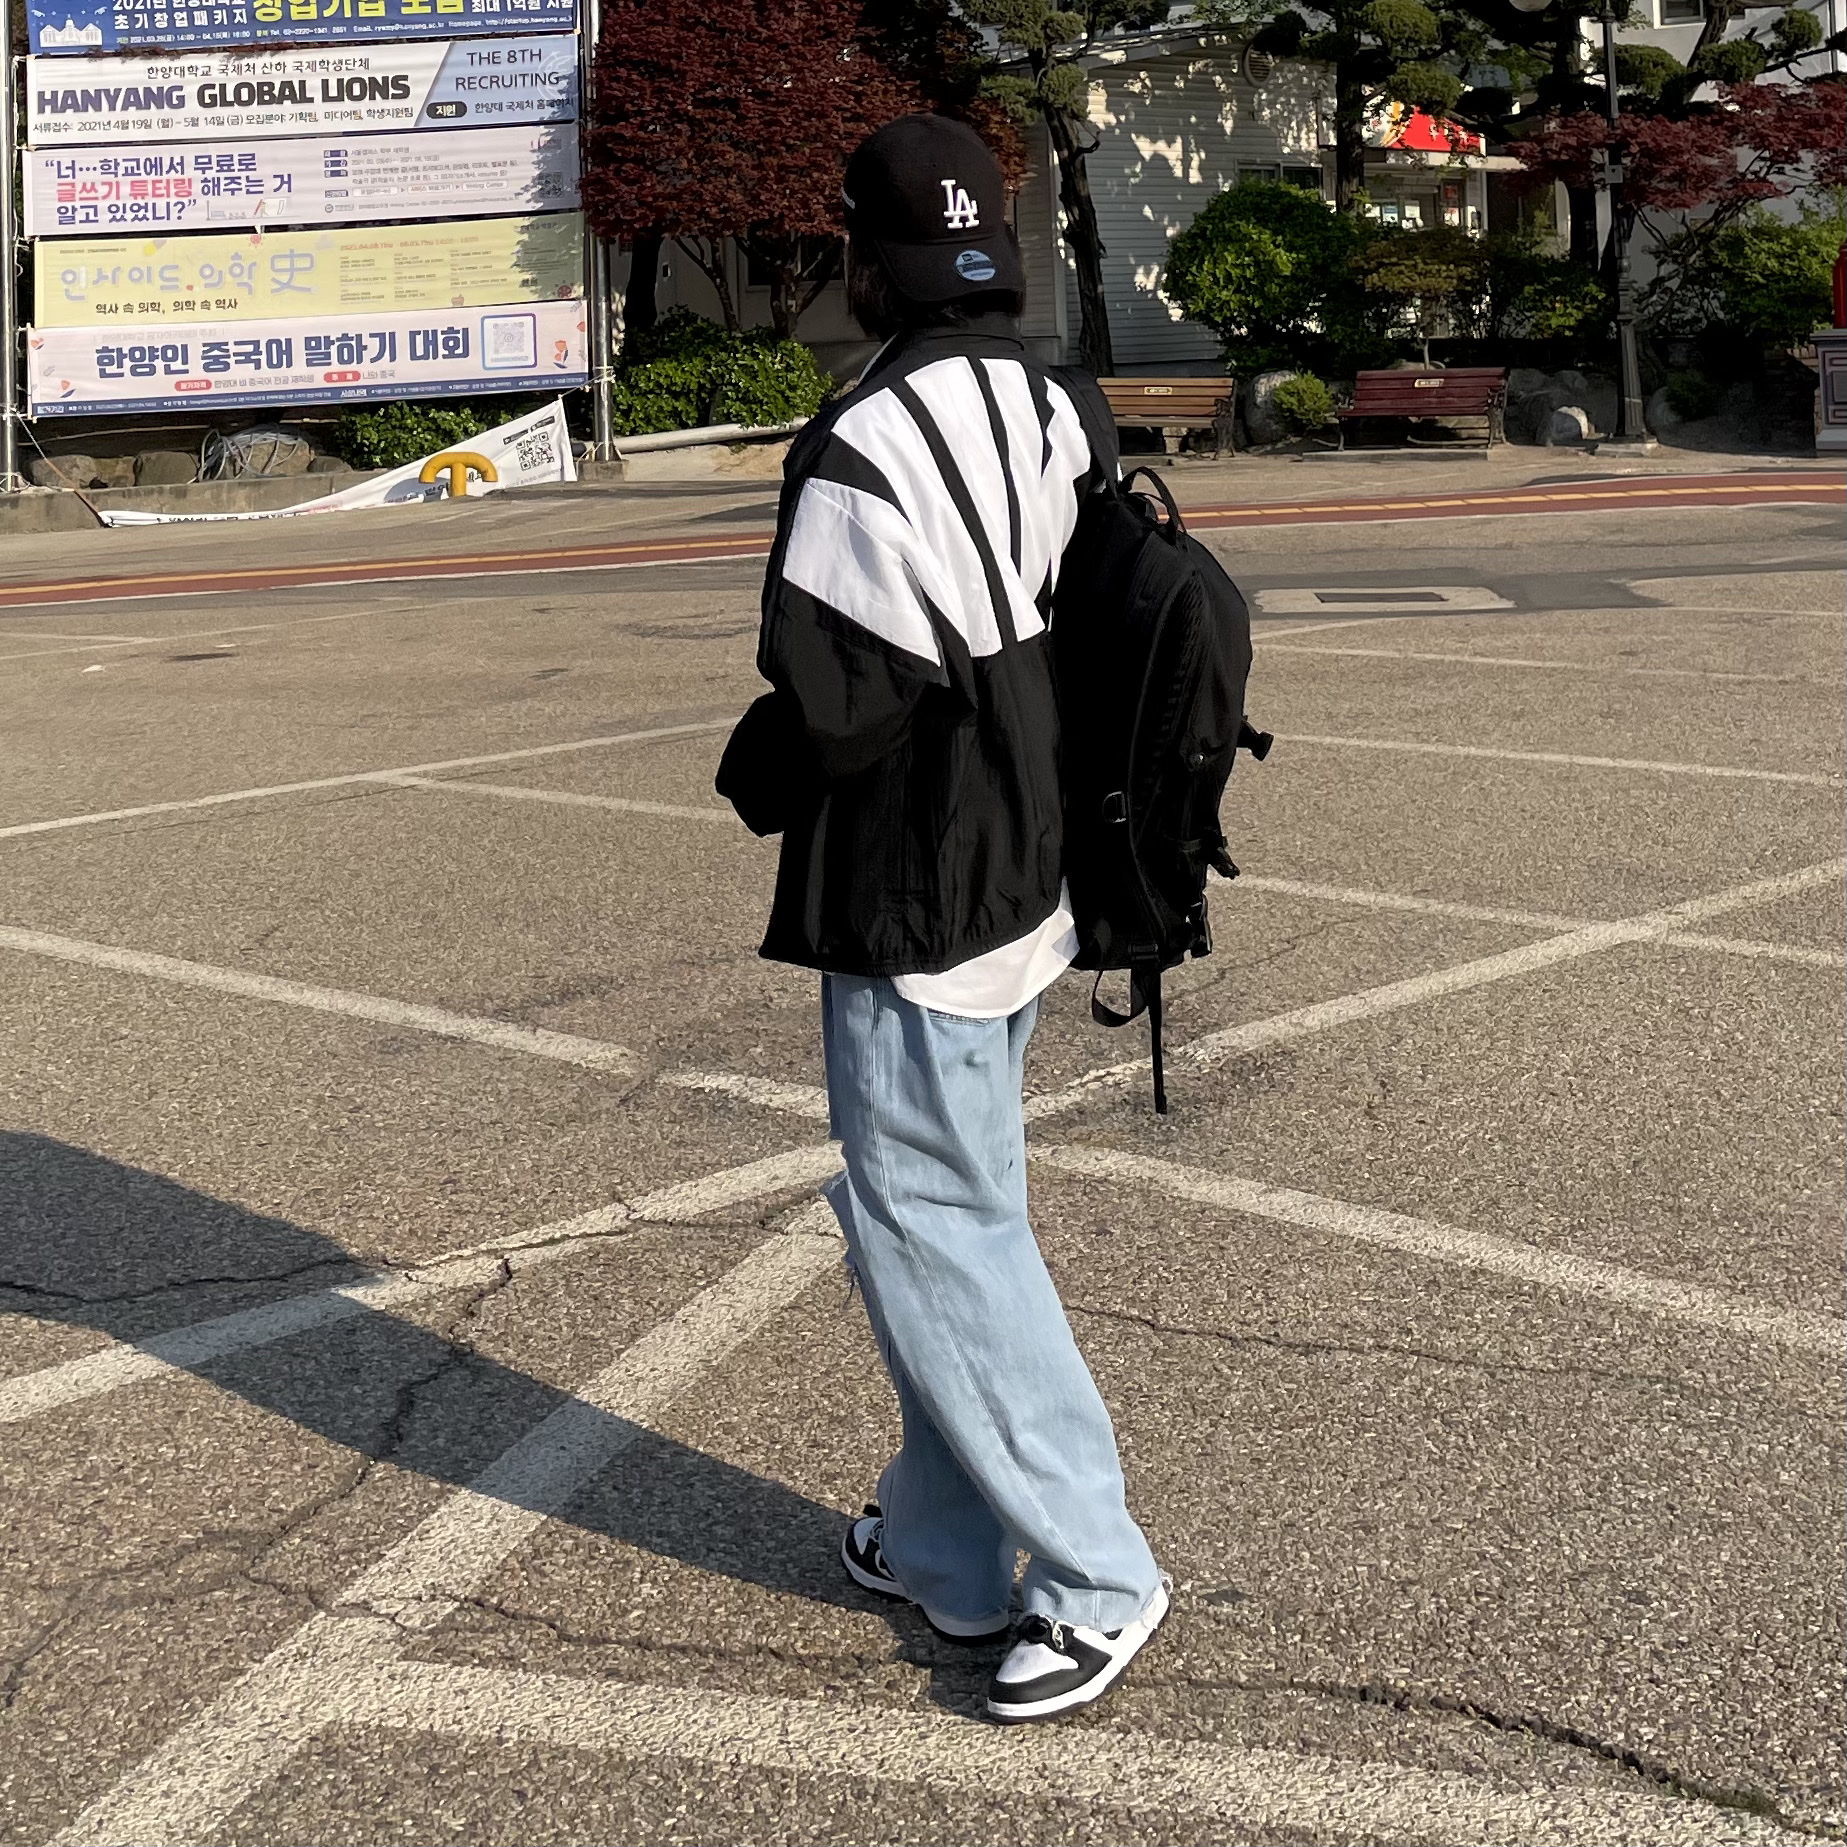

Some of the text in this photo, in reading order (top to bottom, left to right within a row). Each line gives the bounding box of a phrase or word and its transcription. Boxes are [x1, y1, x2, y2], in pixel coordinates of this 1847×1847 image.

[466, 48, 542, 66] THE 8TH
[147, 57, 371, 79] 한양대학교 국제처 산하 국제학생단체
[455, 72, 560, 92] RECRUITING
[37, 74, 411, 115] HANYANG GLOBAL LIONS
[435, 104, 457, 116] 지원
[475, 102, 502, 114] 한양대
[193, 153, 257, 174] 무료로
[56, 173, 293, 202] 글쓰기 튜터링 해주는 거
[940, 179, 980, 229] LA
[56, 205, 99, 226] 알고
[96, 297, 238, 315] 역사 속 의학, 의학 속 역사
[95, 327, 470, 379] 한양인 중국어 말하기 대회
